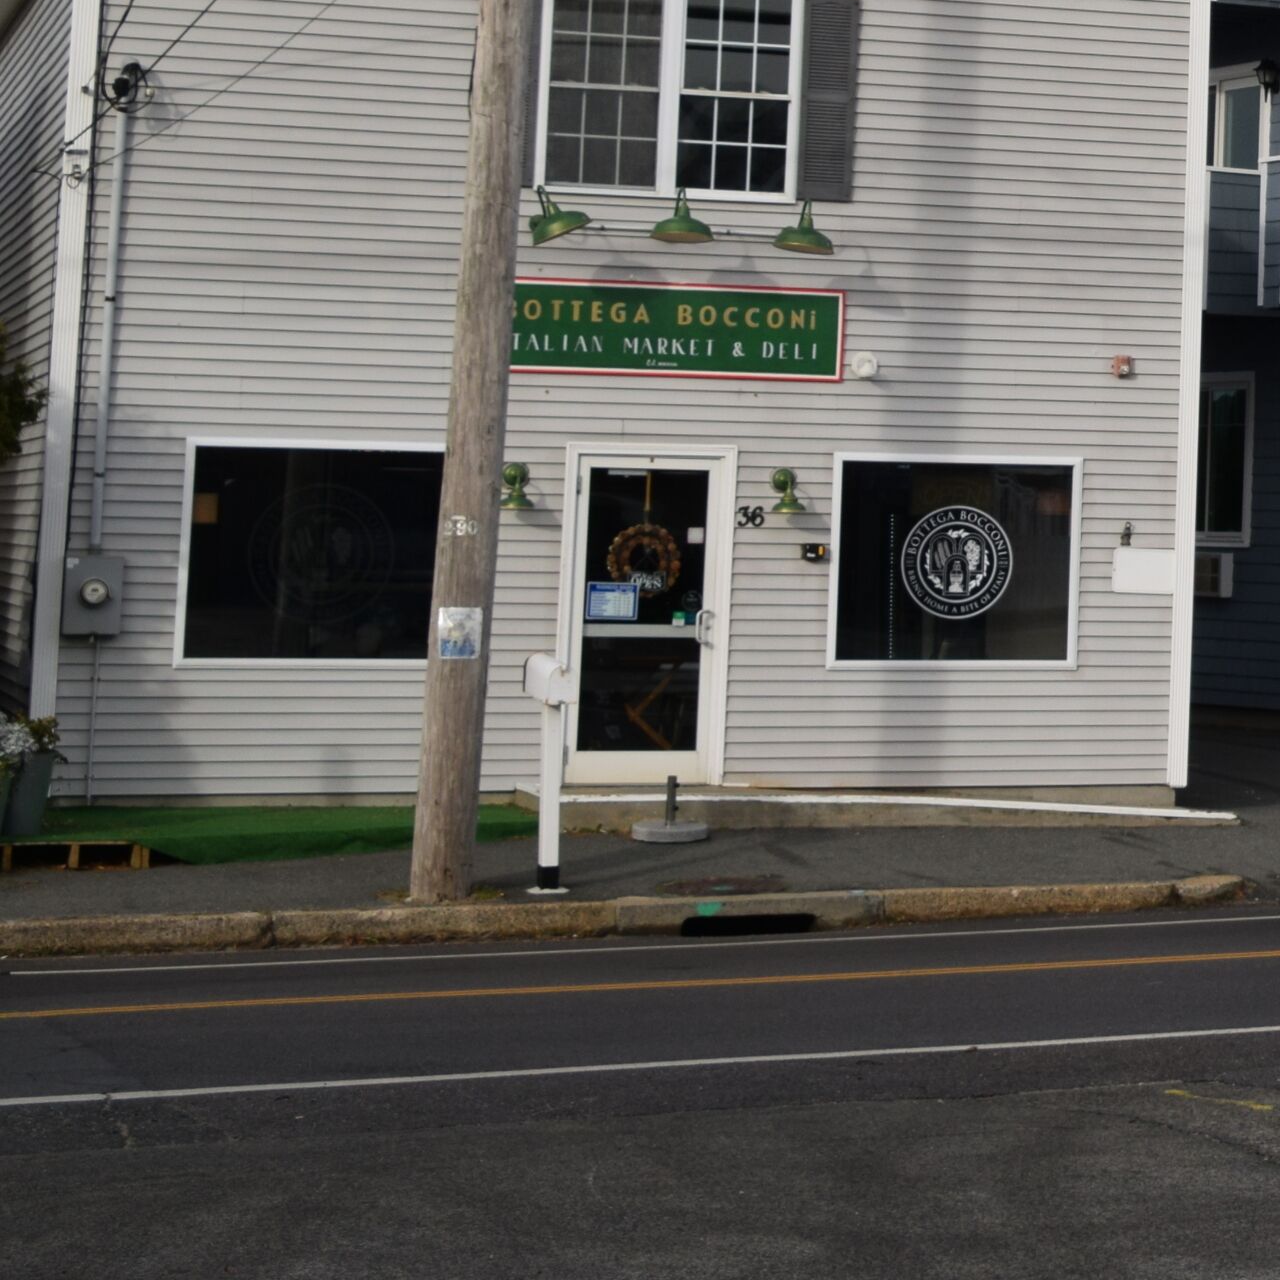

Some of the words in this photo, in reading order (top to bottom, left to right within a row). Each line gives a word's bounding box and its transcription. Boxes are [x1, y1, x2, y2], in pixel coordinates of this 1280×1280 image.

[511, 333, 603, 352] TALIAN
[623, 337, 716, 357] MARKET
[732, 341, 746, 357] &
[762, 341, 818, 360] DELI
[737, 505, 765, 527] 36
[907, 511, 955, 554] BOTTEGA
[960, 510, 1008, 556] BOCCONI
[907, 570, 923, 597] BRING
[924, 597, 948, 613] HOME
[960, 602, 979, 613] BITE
[980, 594, 991, 604] OF
[990, 571, 1006, 594] ITALY
